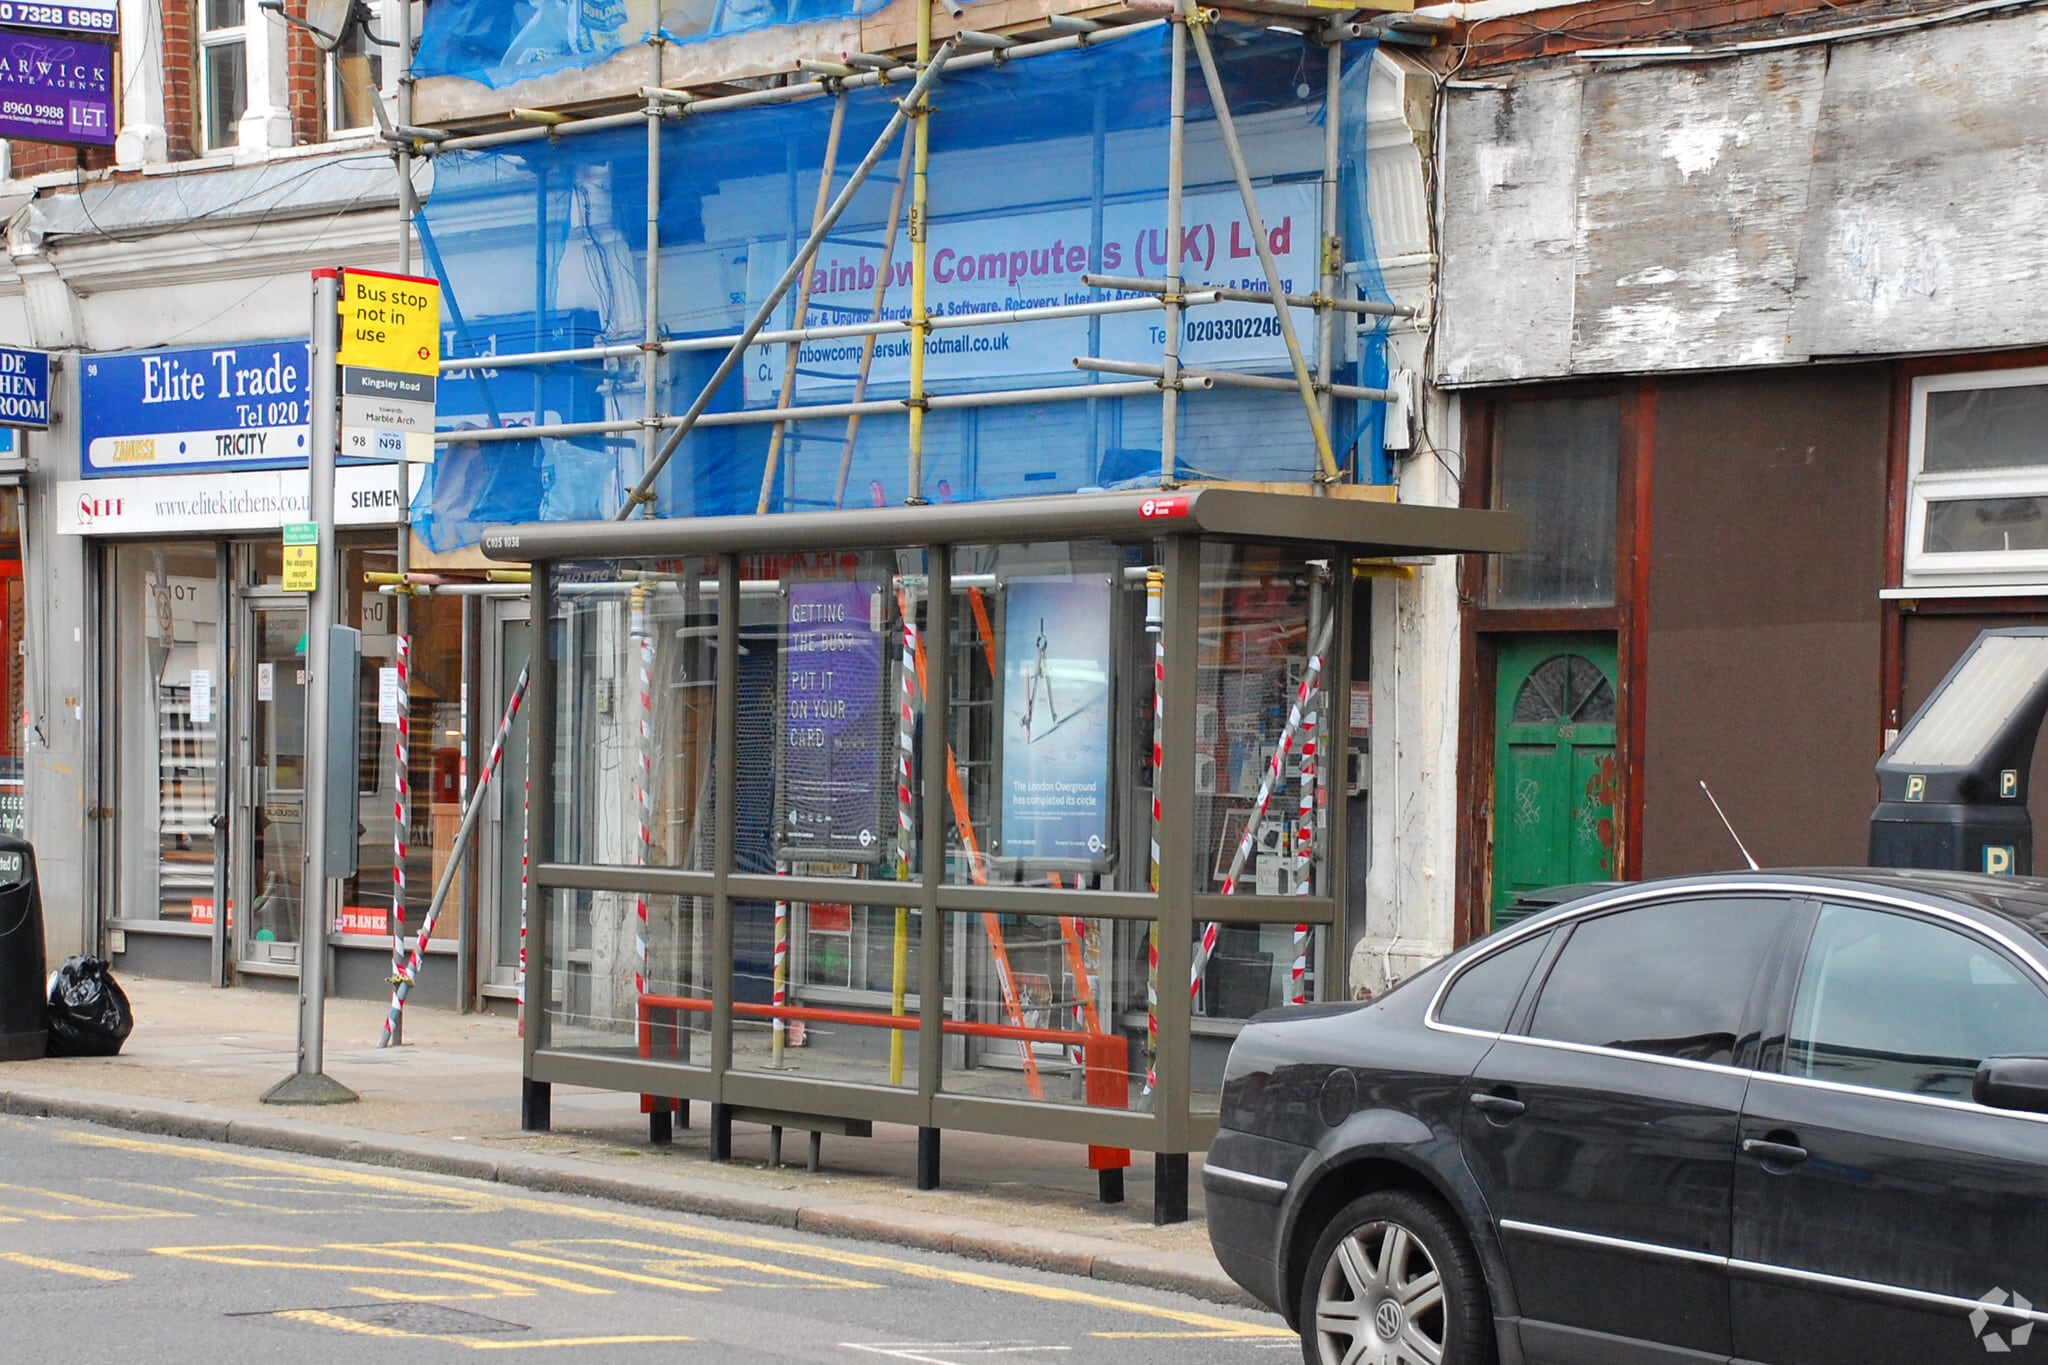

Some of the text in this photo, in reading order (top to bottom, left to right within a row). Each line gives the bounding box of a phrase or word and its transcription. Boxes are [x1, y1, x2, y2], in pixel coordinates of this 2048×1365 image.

[17, 5, 63, 25] 7328
[68, 10, 114, 28] 6969
[3, 101, 33, 116] 8960
[35, 104, 65, 120] 9988
[1135, 223, 1215, 276] (UK)
[1230, 216, 1292, 259] Ld
[357, 284, 428, 311] Bus stop
[357, 306, 405, 325] not in
[356, 328, 386, 343] use
[1, 353, 26, 375] DE
[141, 356, 205, 404] Elite
[212, 349, 297, 399] Trade
[361, 376, 421, 391] Kingsley Road
[236, 404, 263, 427] Tel
[267, 401, 299, 425] 020
[366, 412, 416, 425] Marble Arch
[215, 431, 268, 457] TRICITY
[352, 435, 402, 450] 98 N98
[351, 489, 399, 508] SIEMEN
[792, 603, 845, 623] GETTING
[791, 632, 855, 652] THE BUS?
[791, 671, 834, 690] PUT IT
[790, 700, 846, 719] ON YOUR
[789, 728, 825, 747] CARD
[1013, 780, 1097, 793] The London Overground
[1908, 777, 1923, 799] P
[2003, 773, 2015, 795] P
[1013, 795, 1097, 807] has completed its circle
[1987, 847, 2009, 876] P
[343, 913, 387, 929] FRANKE
